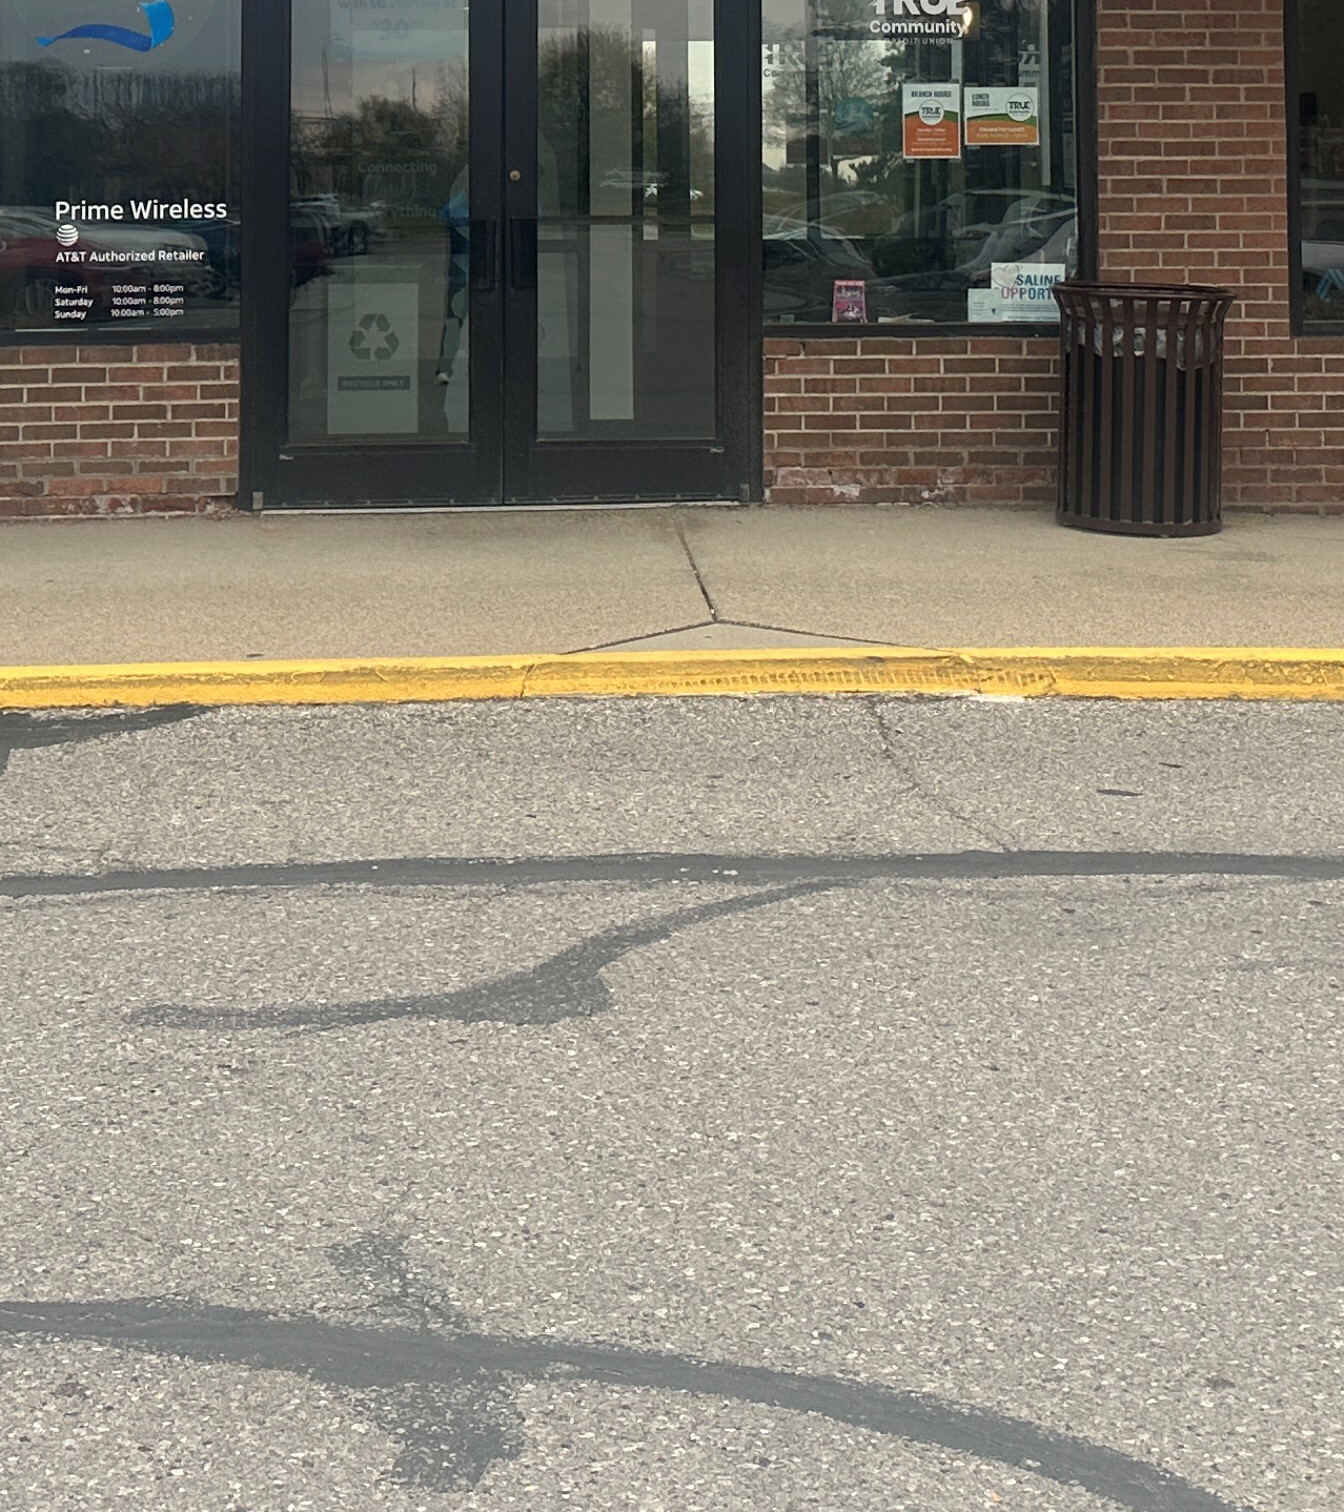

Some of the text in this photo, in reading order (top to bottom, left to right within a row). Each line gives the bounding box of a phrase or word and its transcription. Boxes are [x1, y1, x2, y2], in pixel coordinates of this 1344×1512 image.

[869, 19, 966, 38] Community
[358, 161, 437, 176] Connecting
[55, 197, 228, 221] Prime Wireless
[56, 249, 205, 263] AT&T Authorized Retailer
[1016, 273, 1061, 287] SALINE
[54, 297, 94, 308] Saturday
[54, 310, 87, 321] Sunday
